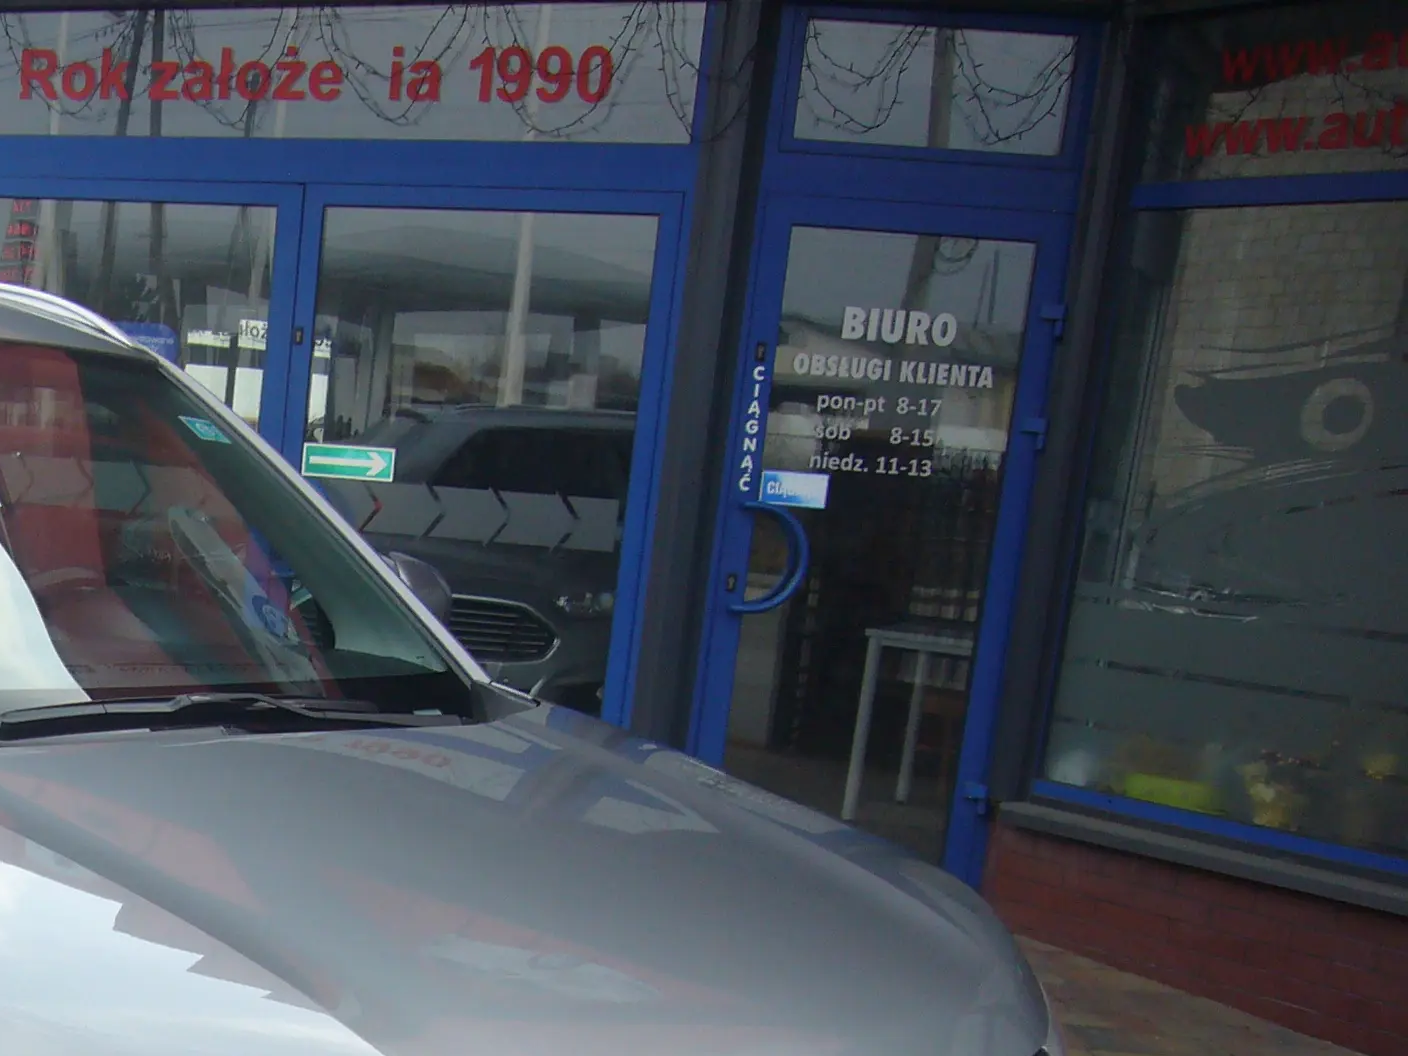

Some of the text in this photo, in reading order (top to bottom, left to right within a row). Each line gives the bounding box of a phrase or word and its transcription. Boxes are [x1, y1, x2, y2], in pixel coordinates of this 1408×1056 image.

[18, 45, 616, 104] Rok założe ia 1990
[841, 305, 957, 347] BIURO
[792, 353, 994, 388] OBSŁUGI KLIENTA
[816, 393, 943, 417] pon-pt 8-17
[889, 426, 935, 447] 8-15
[809, 451, 933, 477] niedz. 11-13
